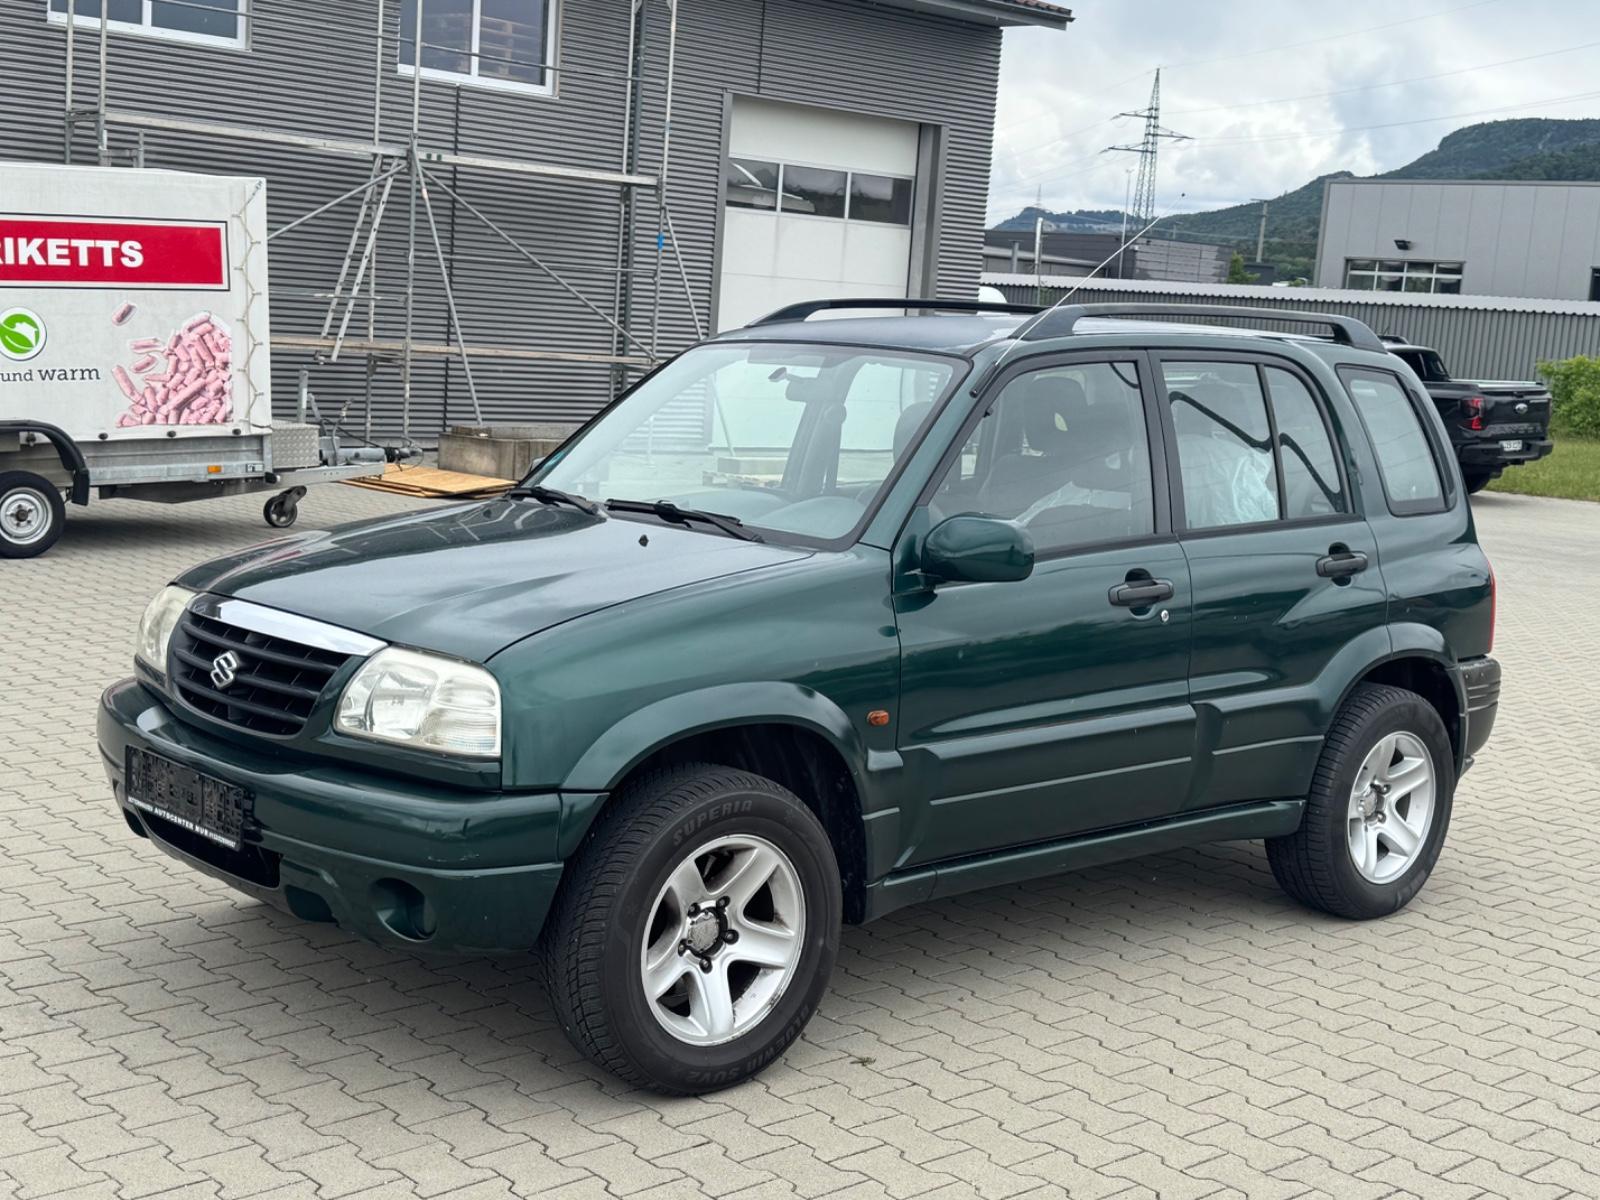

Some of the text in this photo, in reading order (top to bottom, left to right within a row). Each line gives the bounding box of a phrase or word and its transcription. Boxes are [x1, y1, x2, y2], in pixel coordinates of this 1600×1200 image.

[0, 237, 144, 267] IKETTS
[0, 367, 101, 382] und warm
[672, 799, 753, 847] SUPERIA
